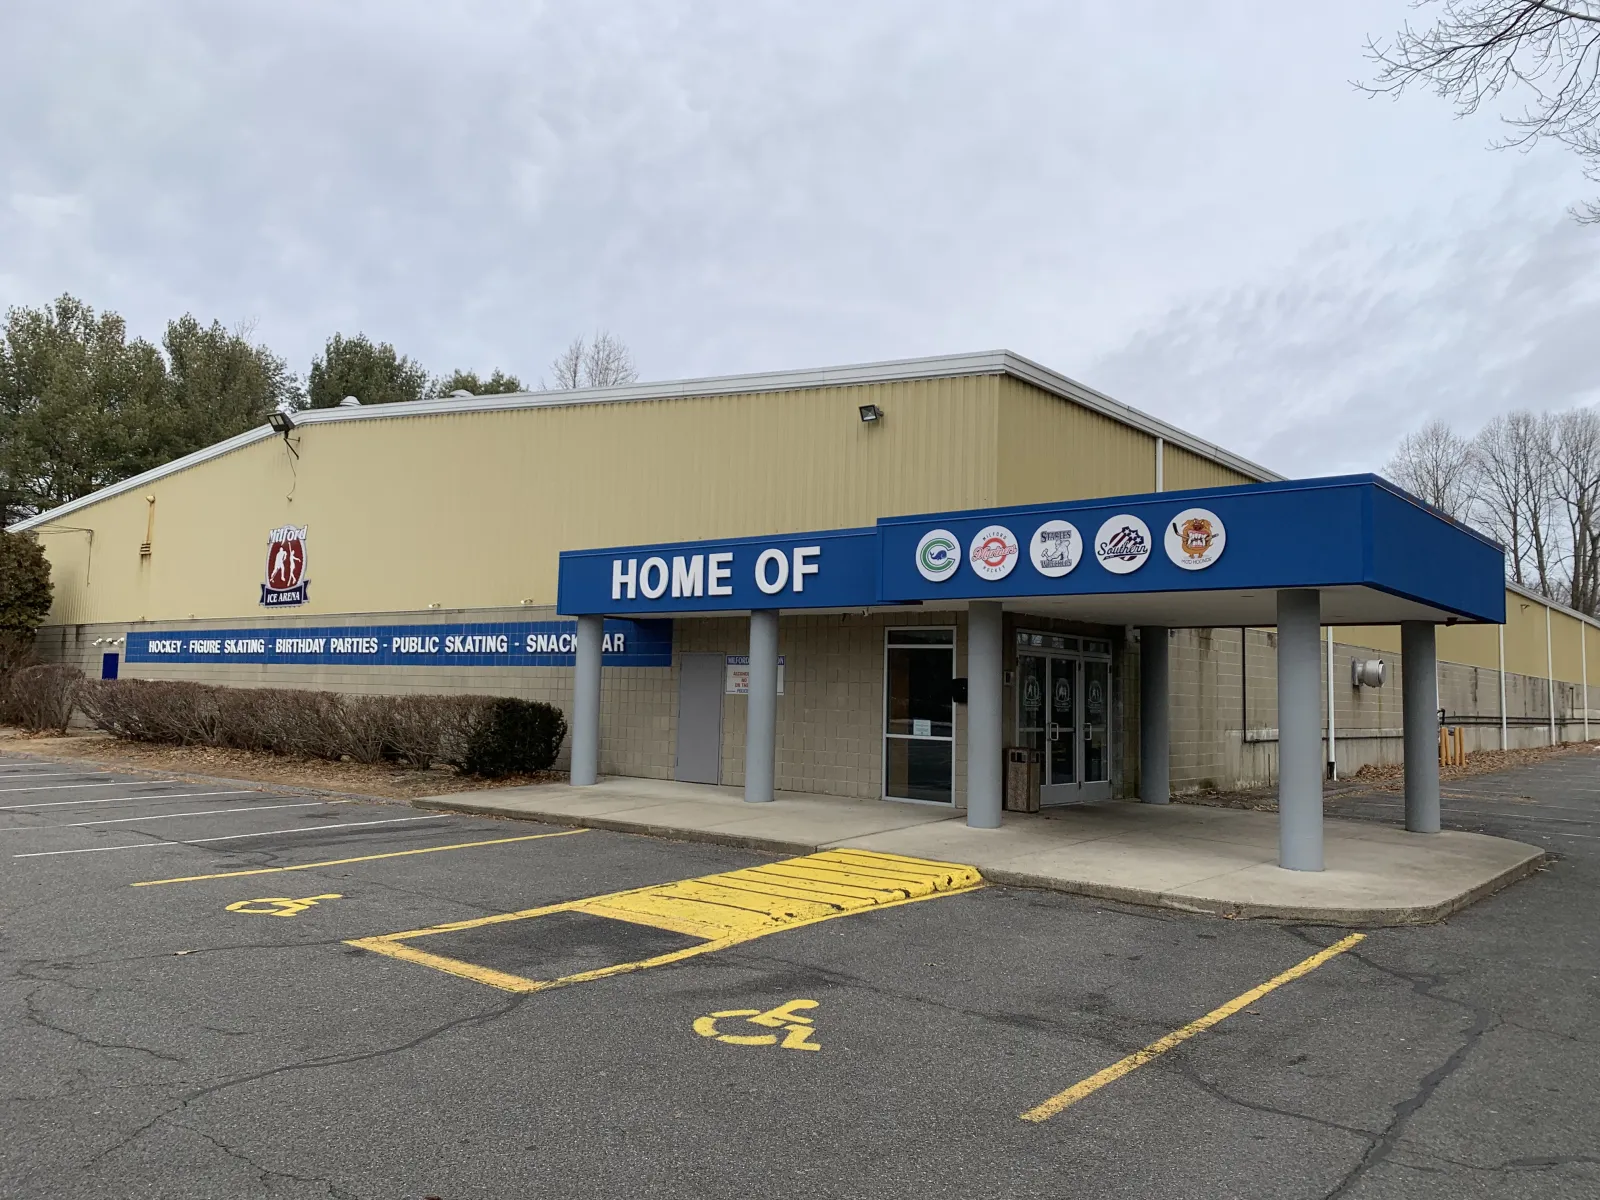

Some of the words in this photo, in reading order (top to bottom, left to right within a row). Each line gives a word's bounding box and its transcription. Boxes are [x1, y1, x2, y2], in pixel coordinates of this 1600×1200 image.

[267, 524, 308, 546] Milford
[982, 531, 1007, 541] MILFORD
[1097, 541, 1148, 556] Southern
[611, 552, 734, 599] HOME
[755, 546, 821, 594] OF
[982, 565, 1006, 573] HOCKEY
[267, 593, 278, 603] ICE
[278, 591, 300, 602] ARENA
[149, 640, 182, 653] HOCKEY
[189, 640, 221, 653] FIGURE
[224, 639, 265, 653] SKATING
[276, 639, 326, 653] BIRTHDAY
[331, 638, 378, 653] PARTIES
[393, 637, 439, 653] PUBLIC
[445, 636, 507, 652] SKATING
[527, 635, 577, 652] SNACK
[602, 633, 625, 652] AR
